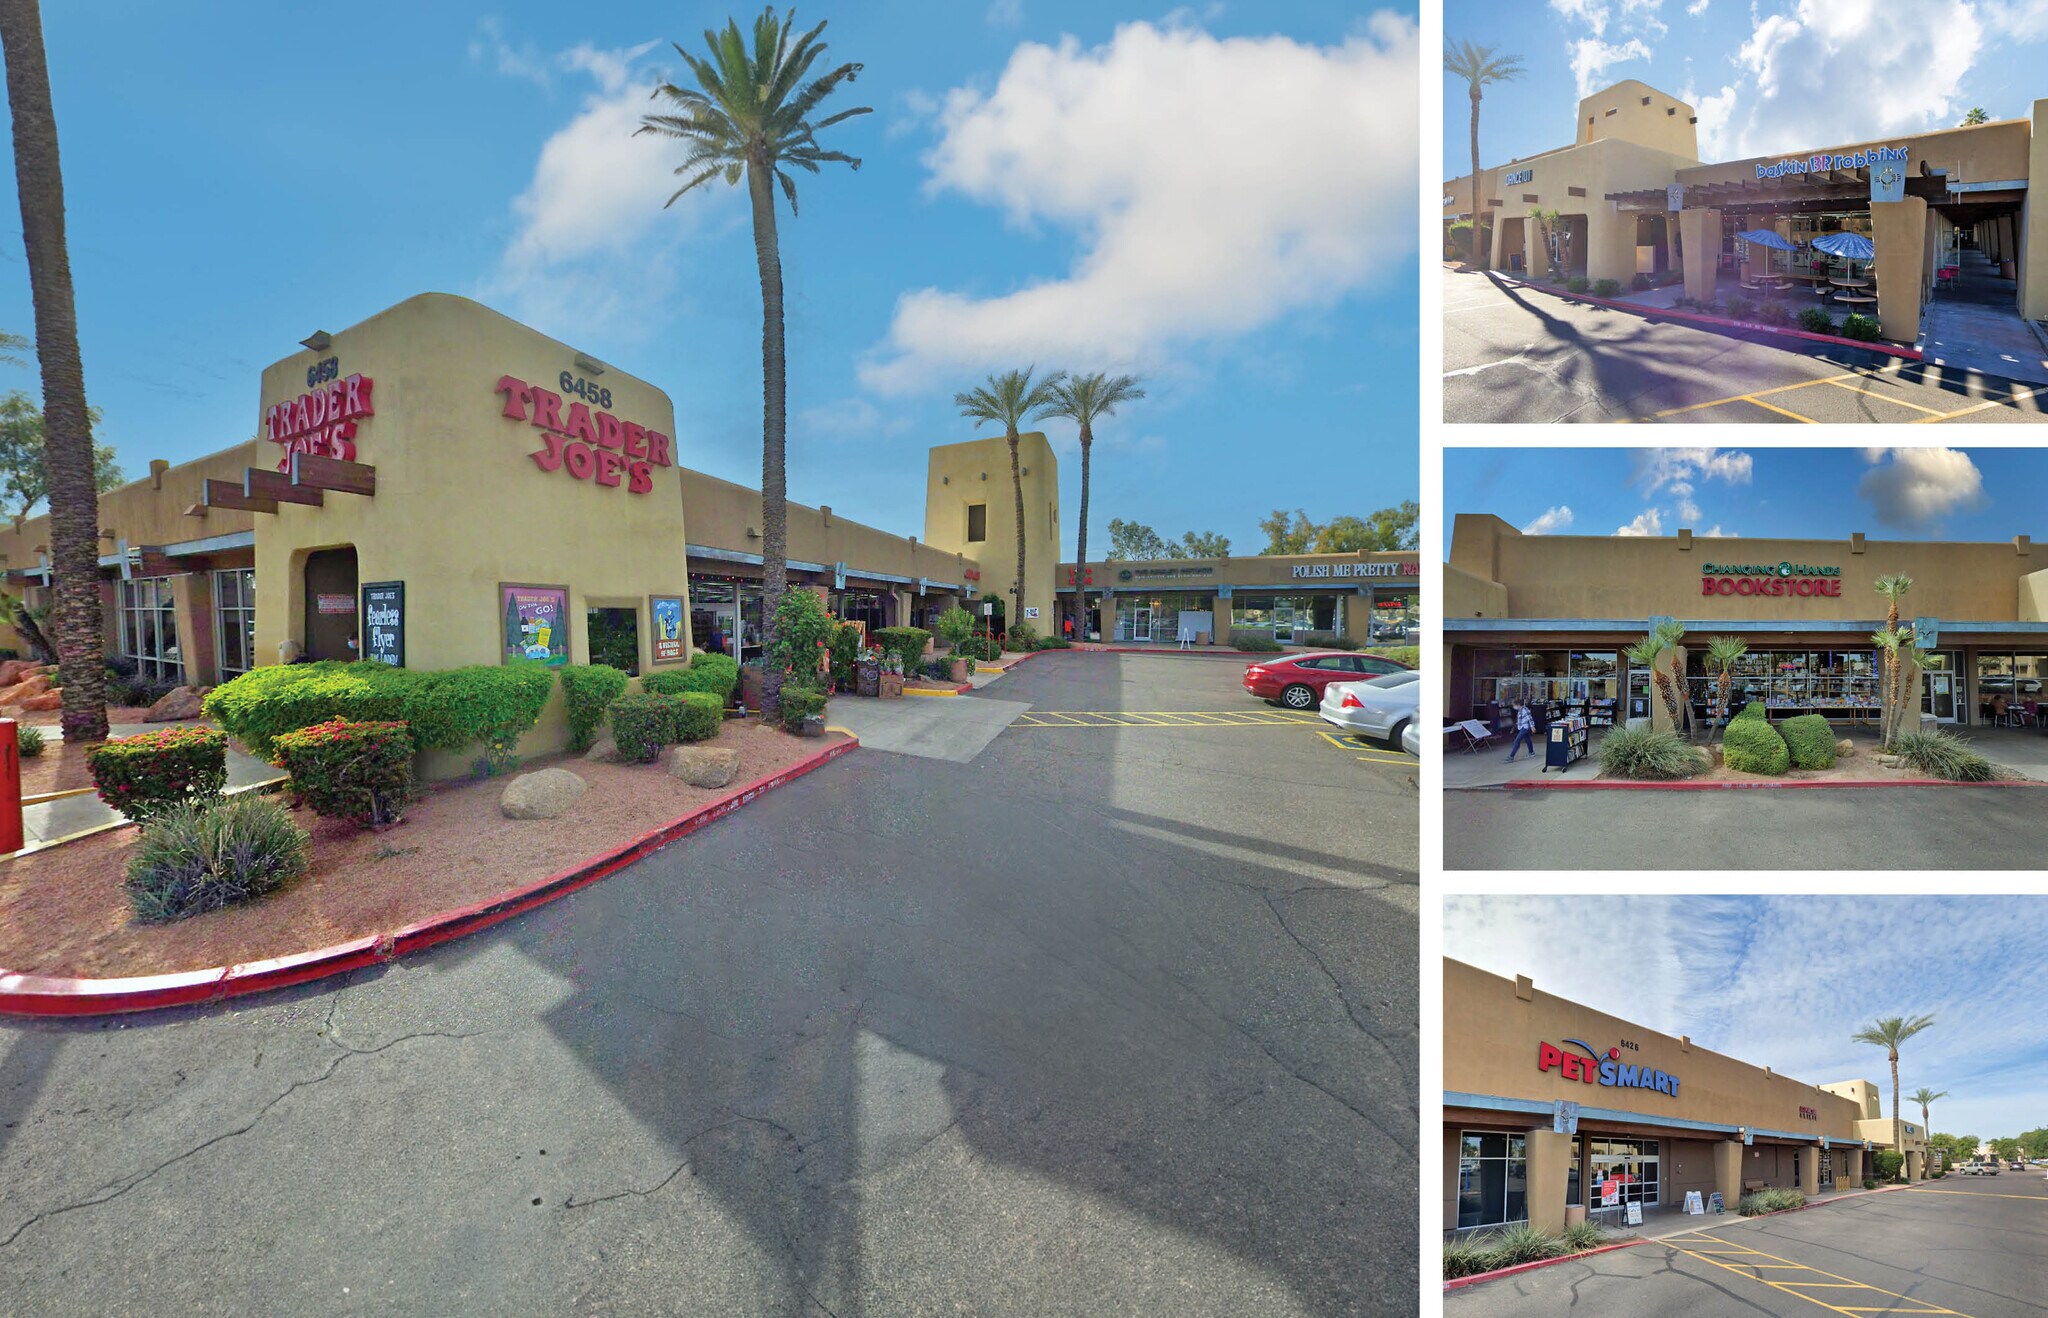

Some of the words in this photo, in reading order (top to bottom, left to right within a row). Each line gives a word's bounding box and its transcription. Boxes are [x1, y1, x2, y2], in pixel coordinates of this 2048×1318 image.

[1756, 159, 1807, 179] baskin
[1810, 155, 1833, 172] BR
[559, 370, 613, 409] 6458
[265, 372, 375, 443] TRADER
[494, 374, 672, 468] TRADER
[528, 432, 654, 495] JOE'S
[1292, 564, 1329, 578] POLISH
[1332, 564, 1350, 577] ME
[1352, 562, 1400, 577] PRETTY
[1702, 562, 1776, 576] CHANGING
[1794, 563, 1841, 576] HANDS
[1701, 577, 1842, 597] BOOKSTORE
[535, 605, 554, 614] GO!
[1538, 1040, 1680, 1097] PETSMART
